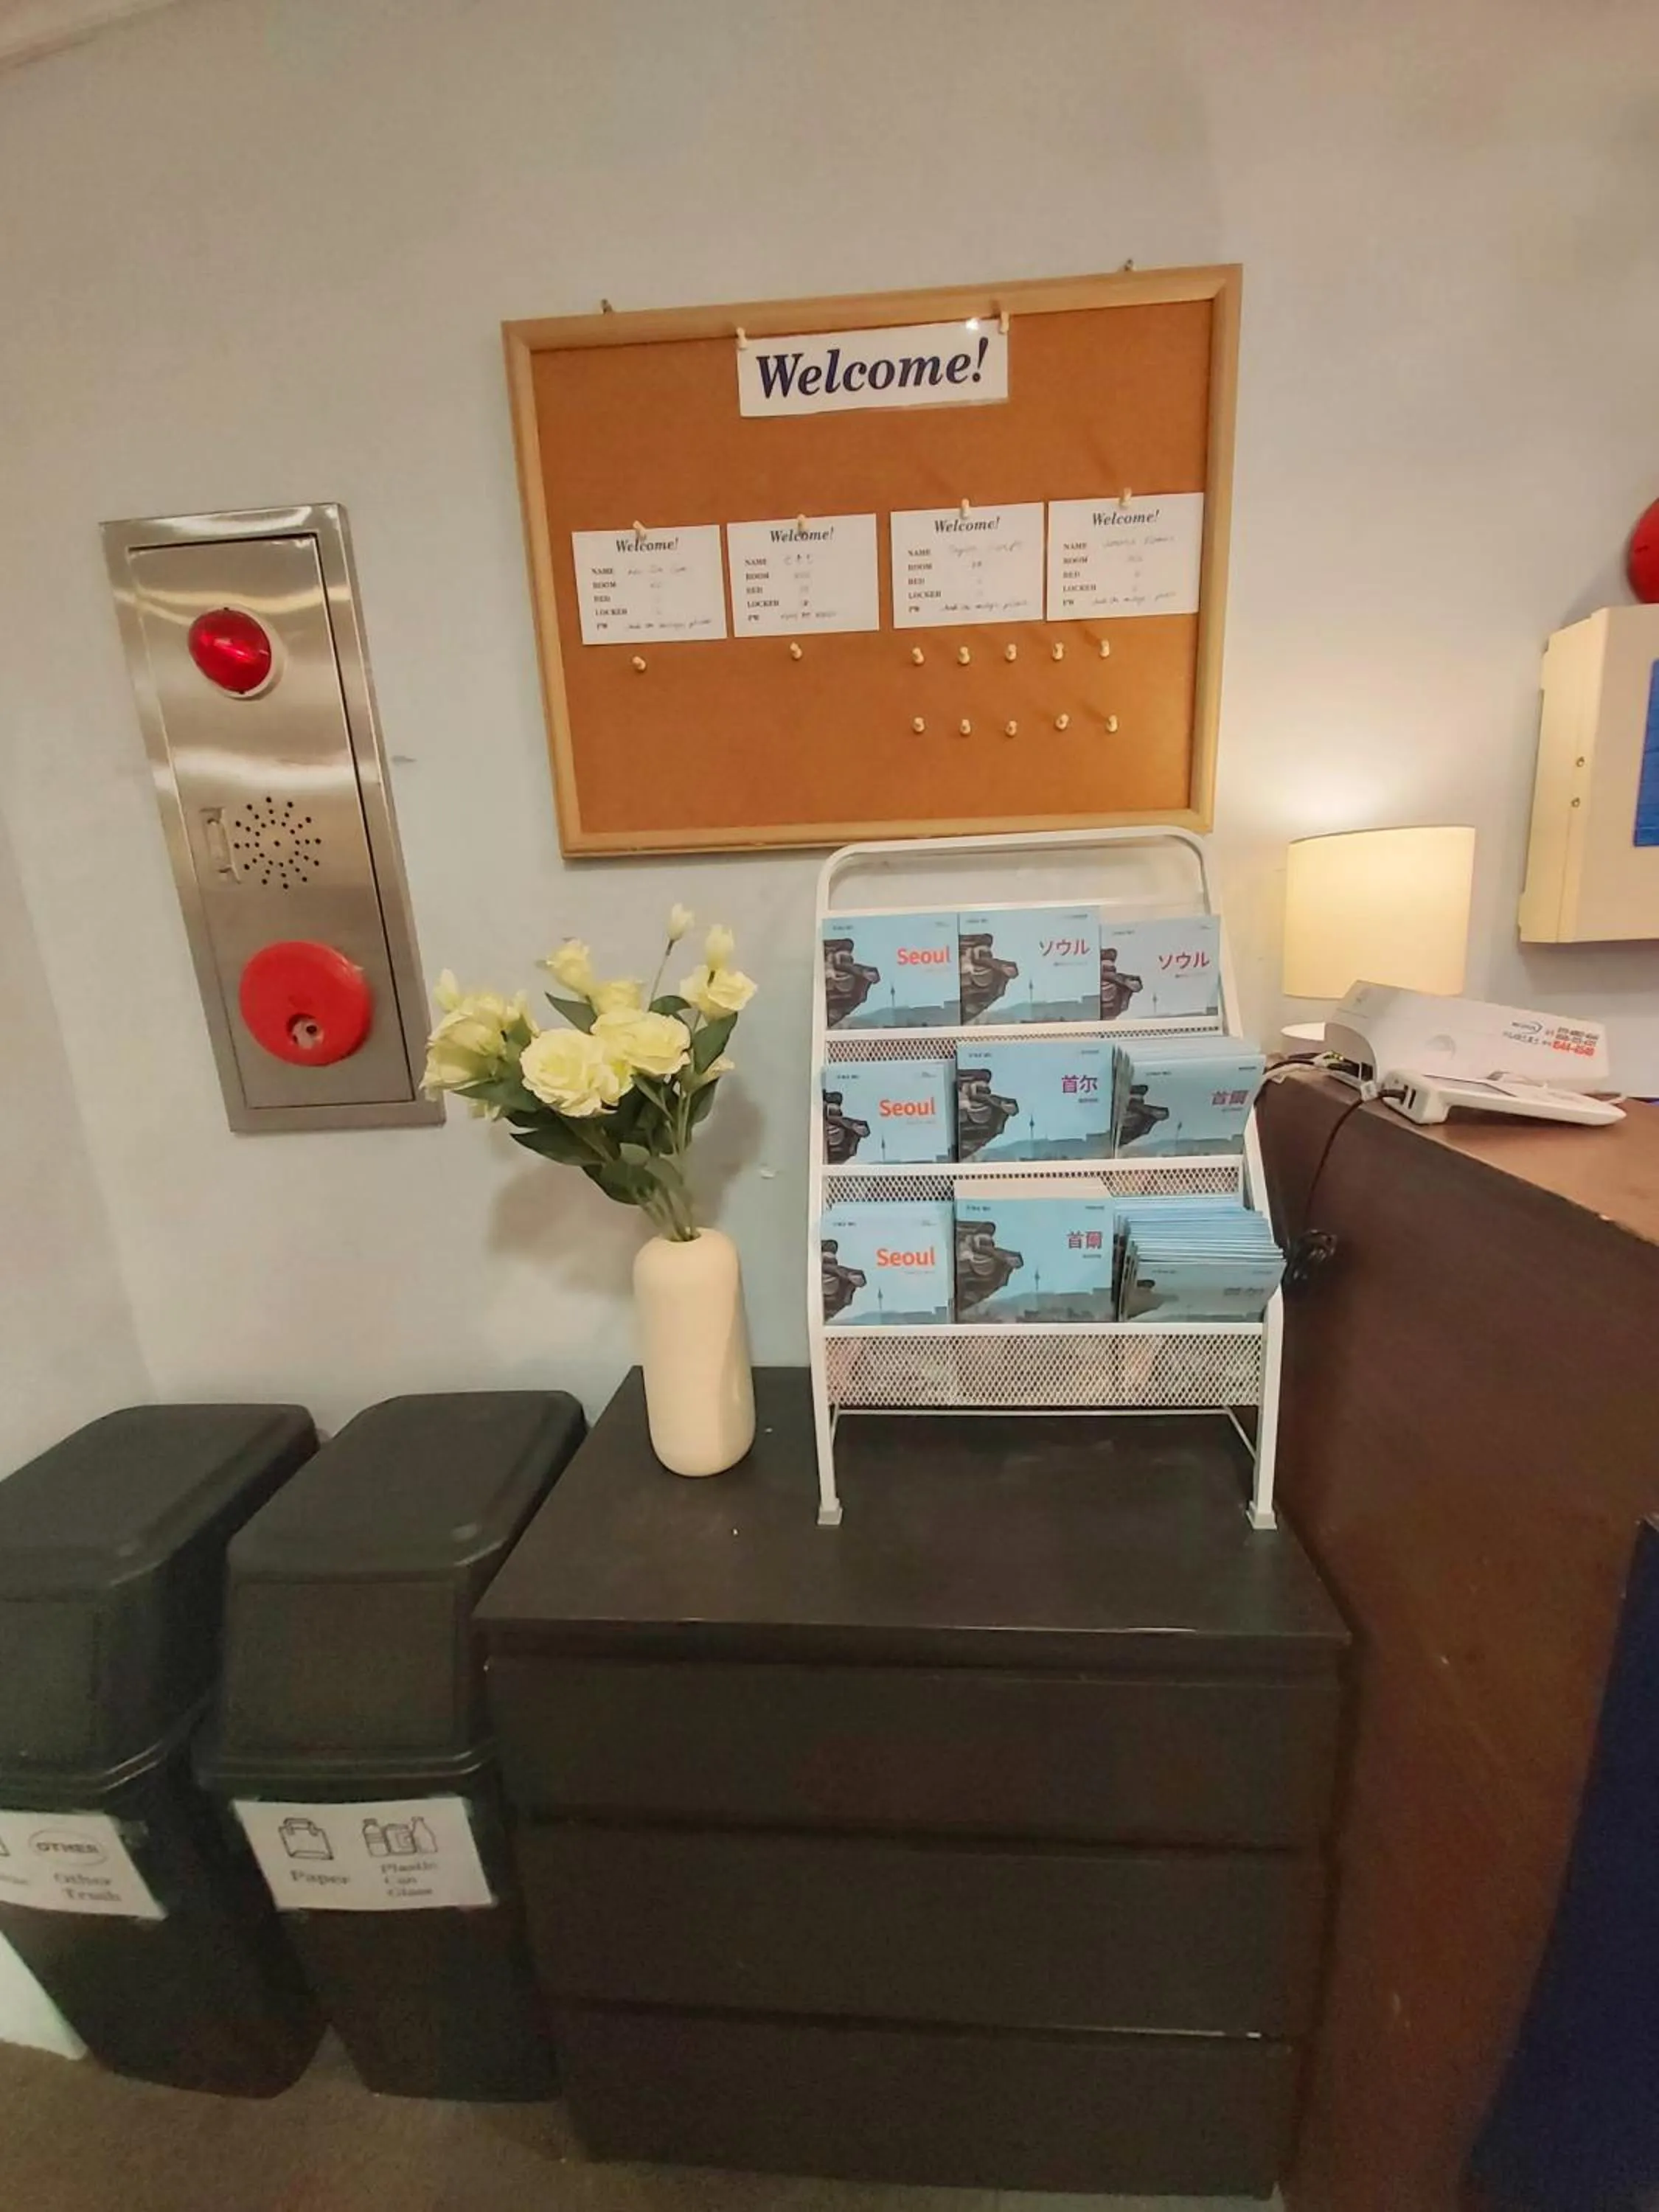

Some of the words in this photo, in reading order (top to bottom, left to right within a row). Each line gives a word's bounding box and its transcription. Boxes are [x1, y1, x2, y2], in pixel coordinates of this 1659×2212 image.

[756, 337, 989, 399] Welcome!
[933, 515, 1001, 533] Welcome!
[1092, 509, 1160, 526] Welcome!
[770, 526, 835, 543] Welcome!
[616, 537, 679, 553] Welcome!
[908, 548, 931, 557] NAME
[1062, 542, 1088, 551] NAME
[591, 566, 614, 575] NAME
[745, 558, 767, 566] NAME
[897, 946, 950, 965] Seoul
[1038, 939, 1090, 957] ソウル
[1158, 951, 1210, 970] ソウル
[1062, 1074, 1098, 1093] 首尔
[880, 1097, 936, 1117] Seoul
[877, 1246, 935, 1267] Seoul
[288, 1869, 351, 1885] Paper
